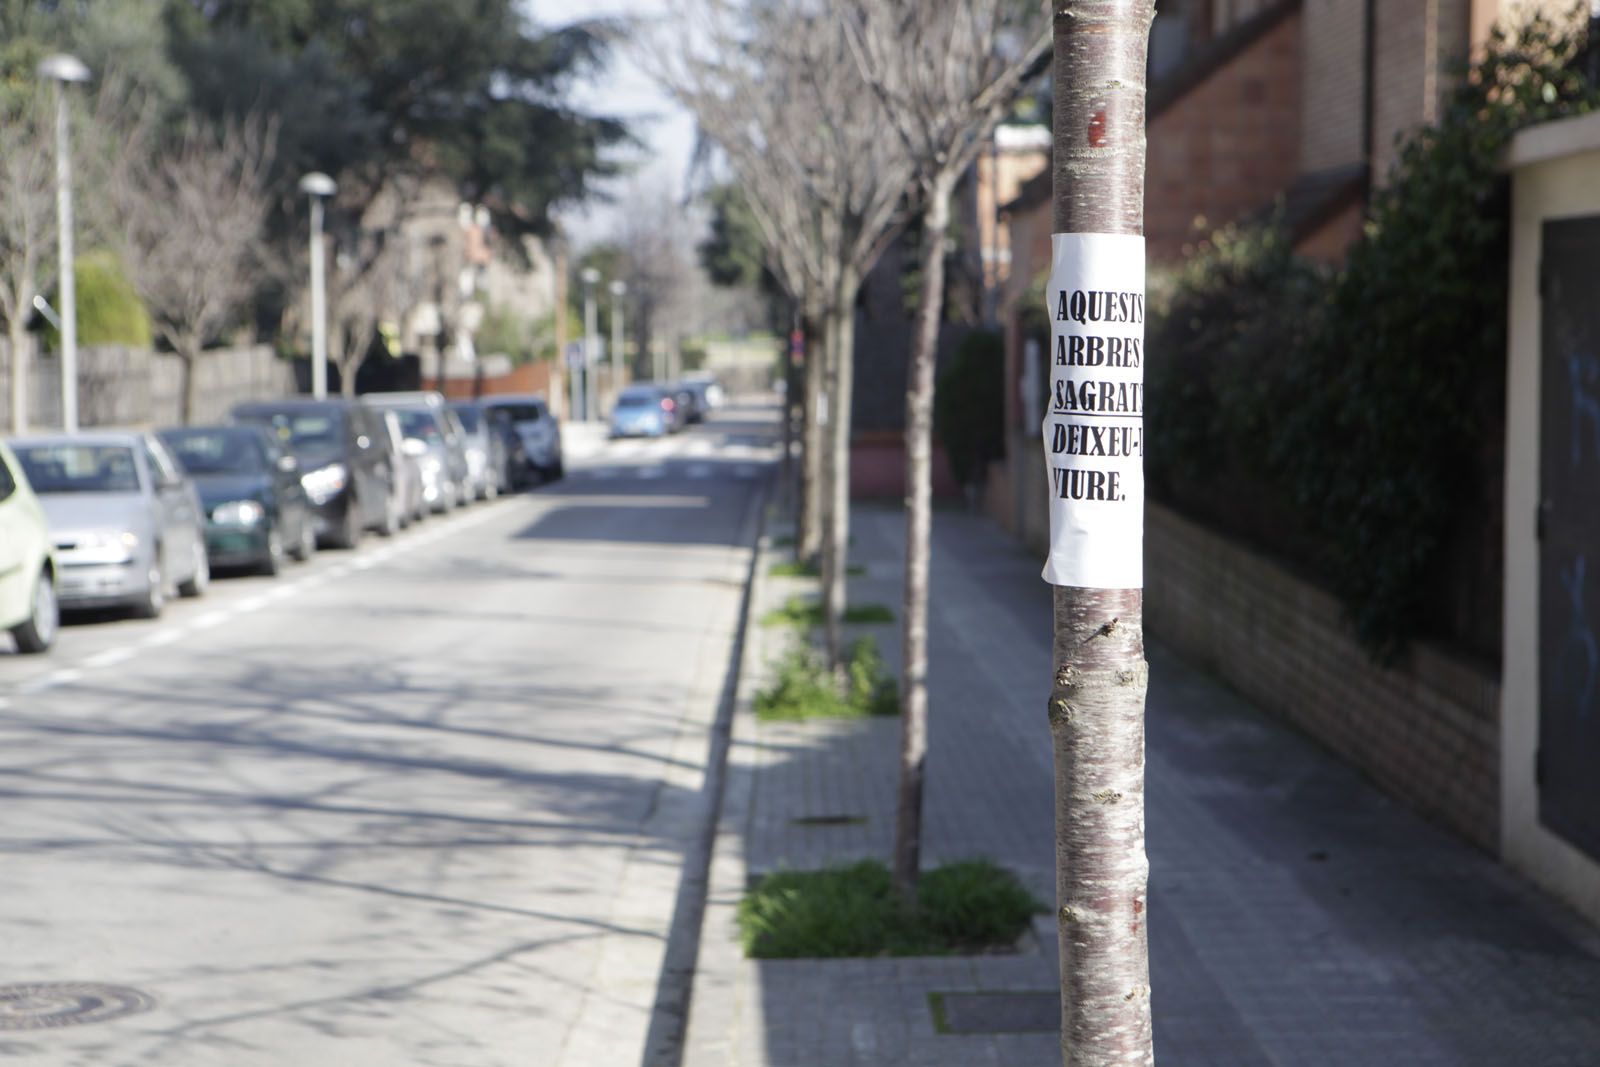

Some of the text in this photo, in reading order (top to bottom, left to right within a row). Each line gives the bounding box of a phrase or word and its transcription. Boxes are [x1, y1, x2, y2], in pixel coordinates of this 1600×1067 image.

[1056, 290, 1143, 325] AQUESTS
[1056, 335, 1140, 368] ARBRES
[1053, 467, 1126, 501] VIURE.
